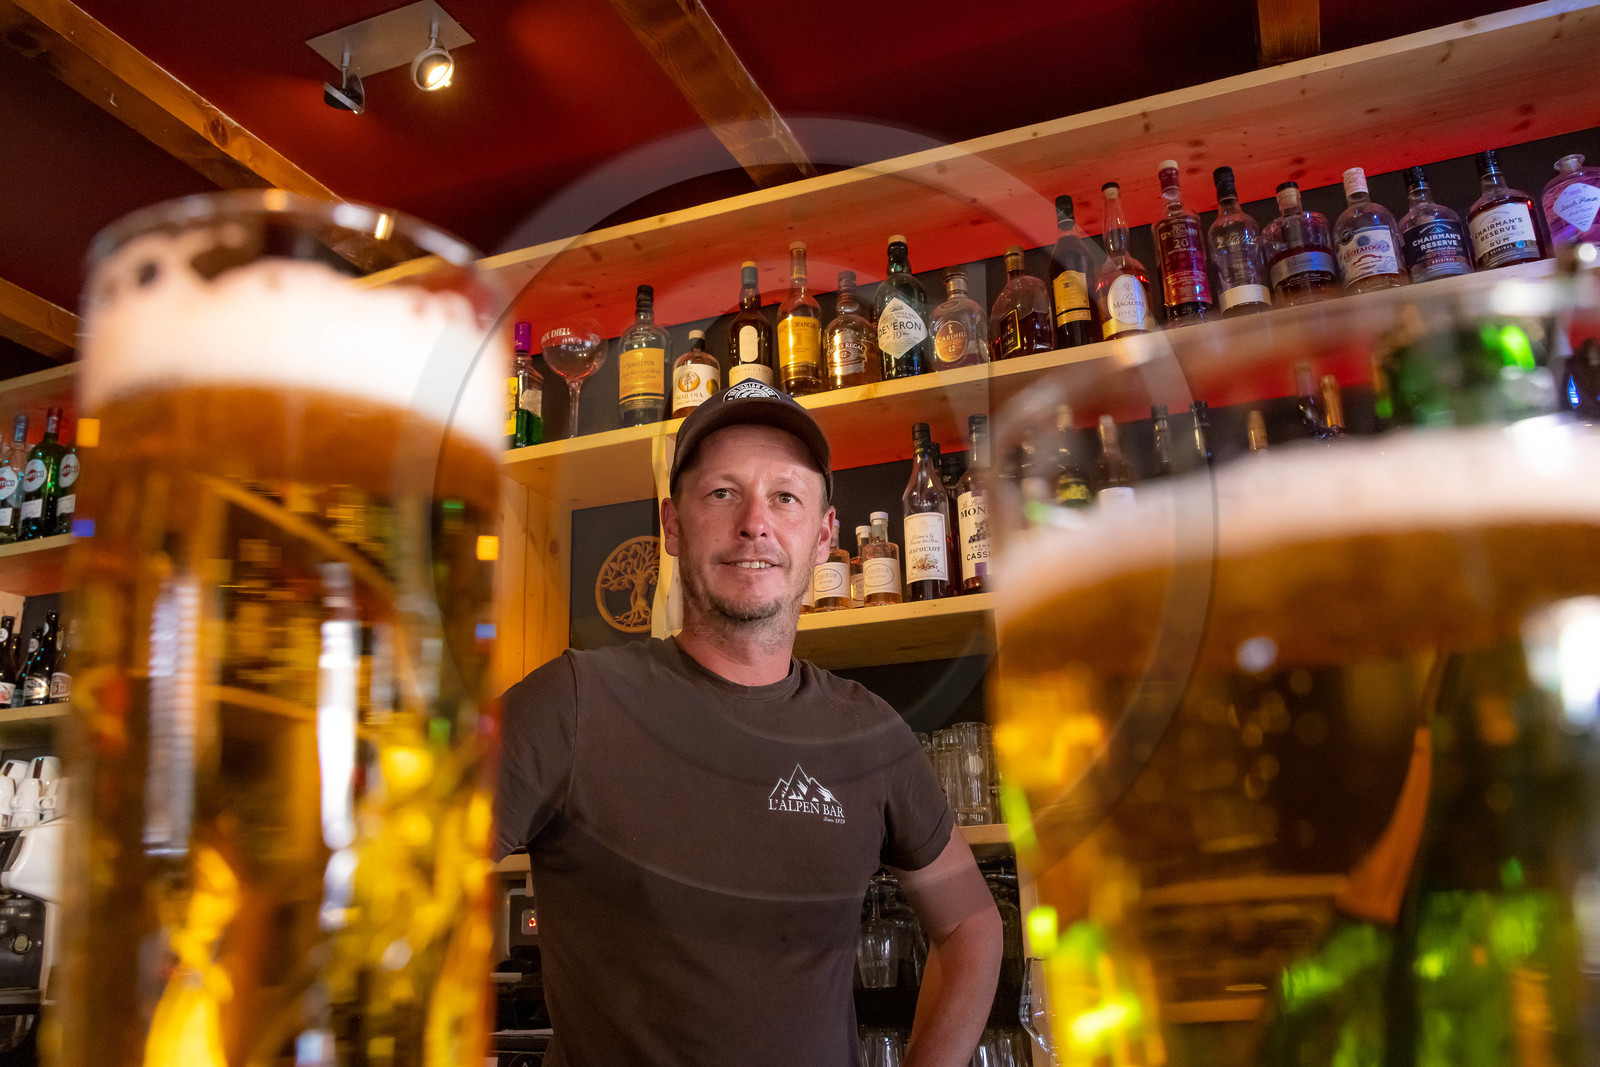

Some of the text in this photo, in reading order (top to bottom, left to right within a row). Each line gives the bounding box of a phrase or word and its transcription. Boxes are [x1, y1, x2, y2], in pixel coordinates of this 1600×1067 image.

[1474, 217, 1523, 240] CHAIRMAN'S
[1480, 224, 1518, 243] RESERVE
[1173, 237, 1190, 249] 20
[1412, 232, 1462, 247] CHAIRMAN'S
[1420, 239, 1458, 251] RESERVE
[1489, 236, 1510, 248] RUM
[878, 321, 922, 338] DEVERON
[937, 331, 967, 344] CARDHU
[948, 344, 957, 353] 12
[737, 383, 761, 391] INDIAN
[822, 803, 845, 819] BAR
